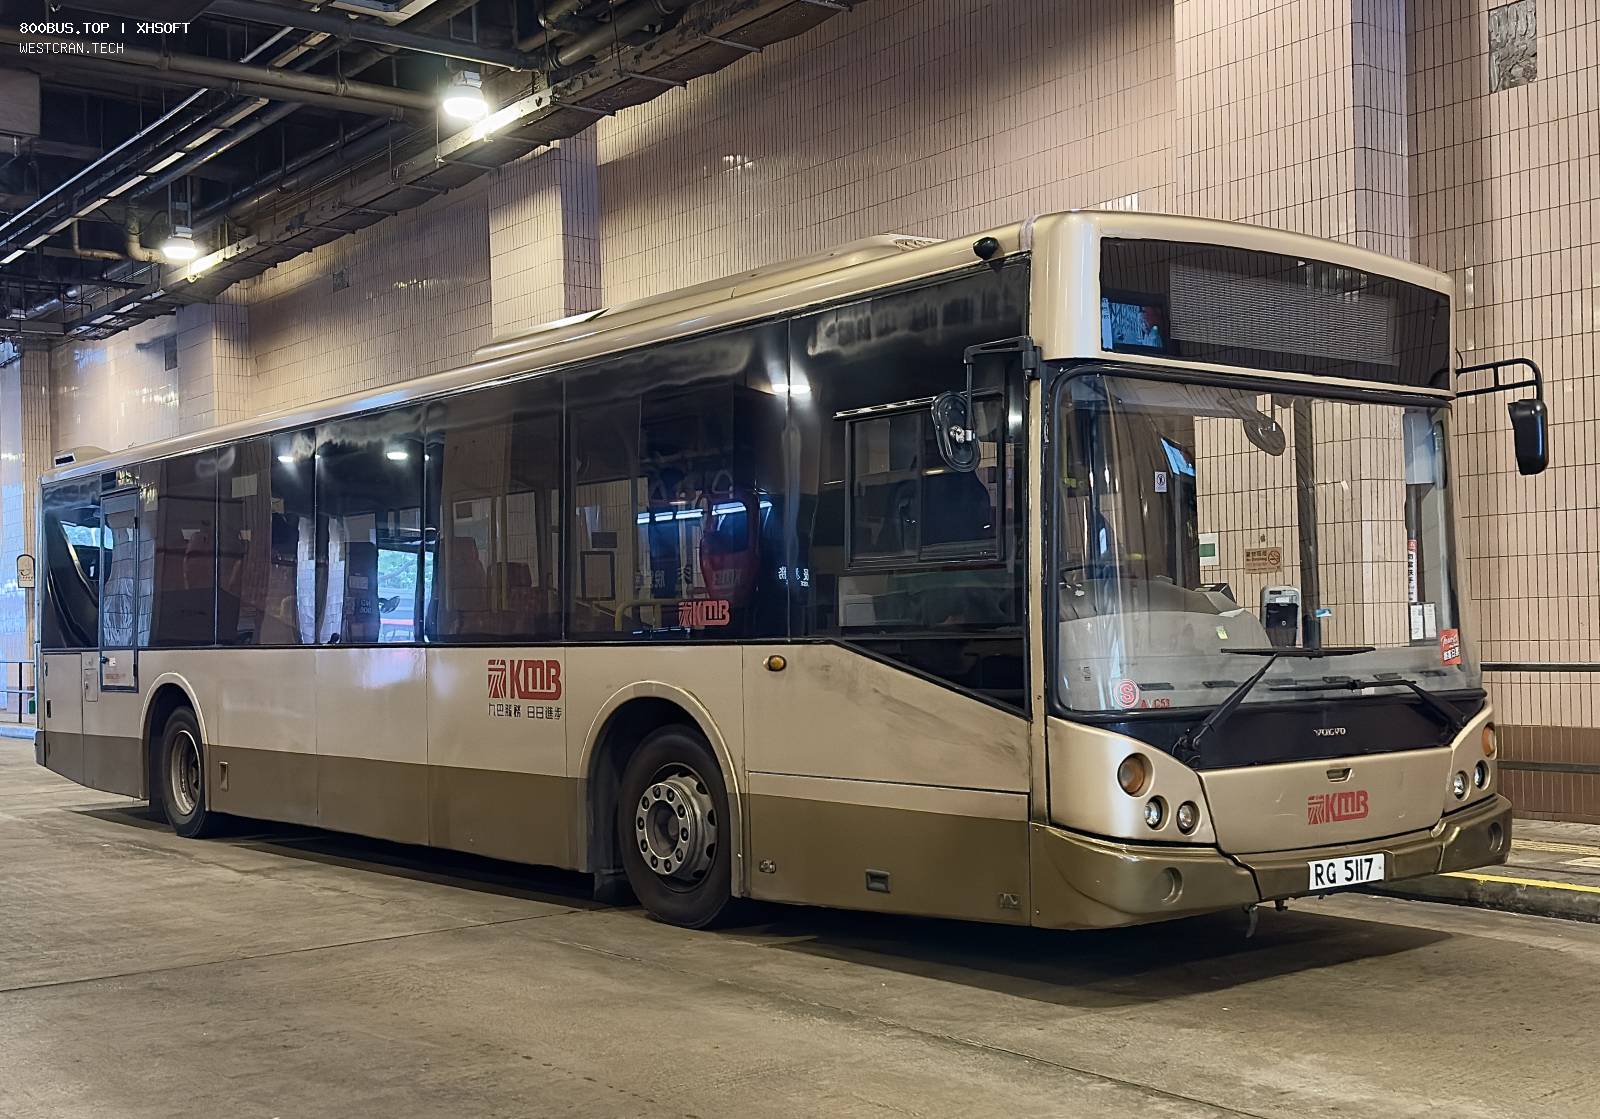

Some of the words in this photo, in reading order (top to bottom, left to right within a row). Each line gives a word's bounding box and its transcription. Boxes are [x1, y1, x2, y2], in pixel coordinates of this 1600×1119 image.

[692, 600, 730, 626] KMB
[510, 660, 562, 700] KMB
[527, 705, 562, 720] 日日進步
[1313, 727, 1347, 736] VOLVO
[1326, 790, 1369, 823] KMB
[1315, 862, 1337, 886] RG
[1344, 857, 1374, 881] 5117
